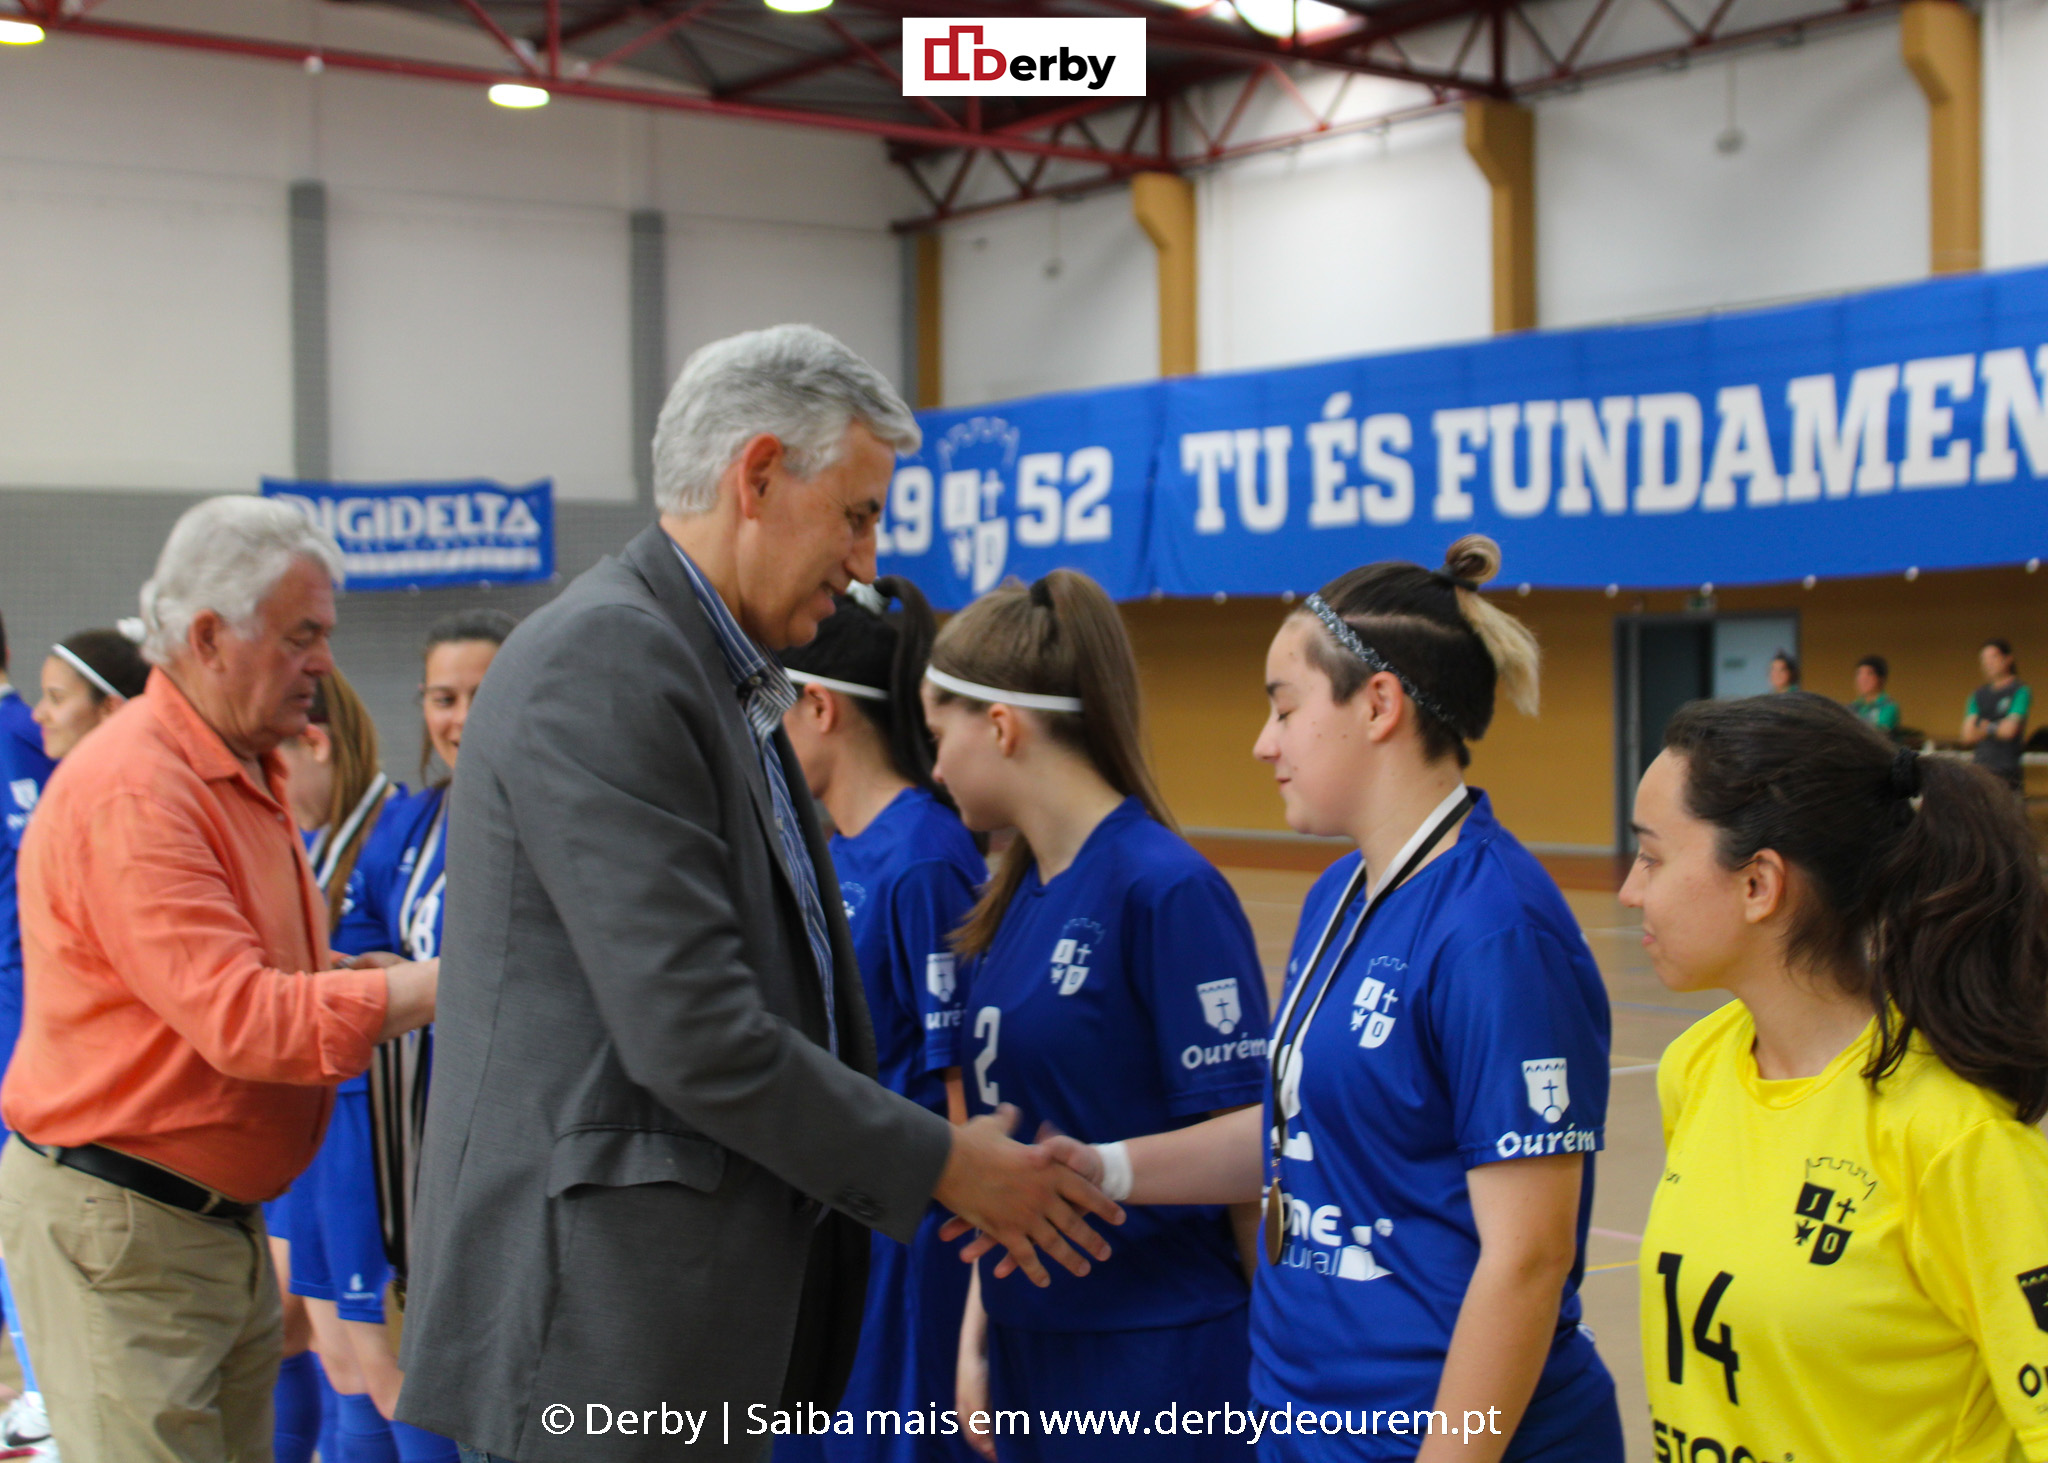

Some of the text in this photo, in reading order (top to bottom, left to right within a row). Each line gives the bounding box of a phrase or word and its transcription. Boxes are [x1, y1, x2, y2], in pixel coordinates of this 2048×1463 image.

[1180, 344, 2048, 535] TU ÉS FUNDAMEN
[1015, 445, 1113, 548] 52
[974, 1005, 1001, 1107] 2
[1181, 1031, 1267, 1070] Ourém
[1496, 1121, 1596, 1159] Ourém
[1657, 1252, 1740, 1406] 14
